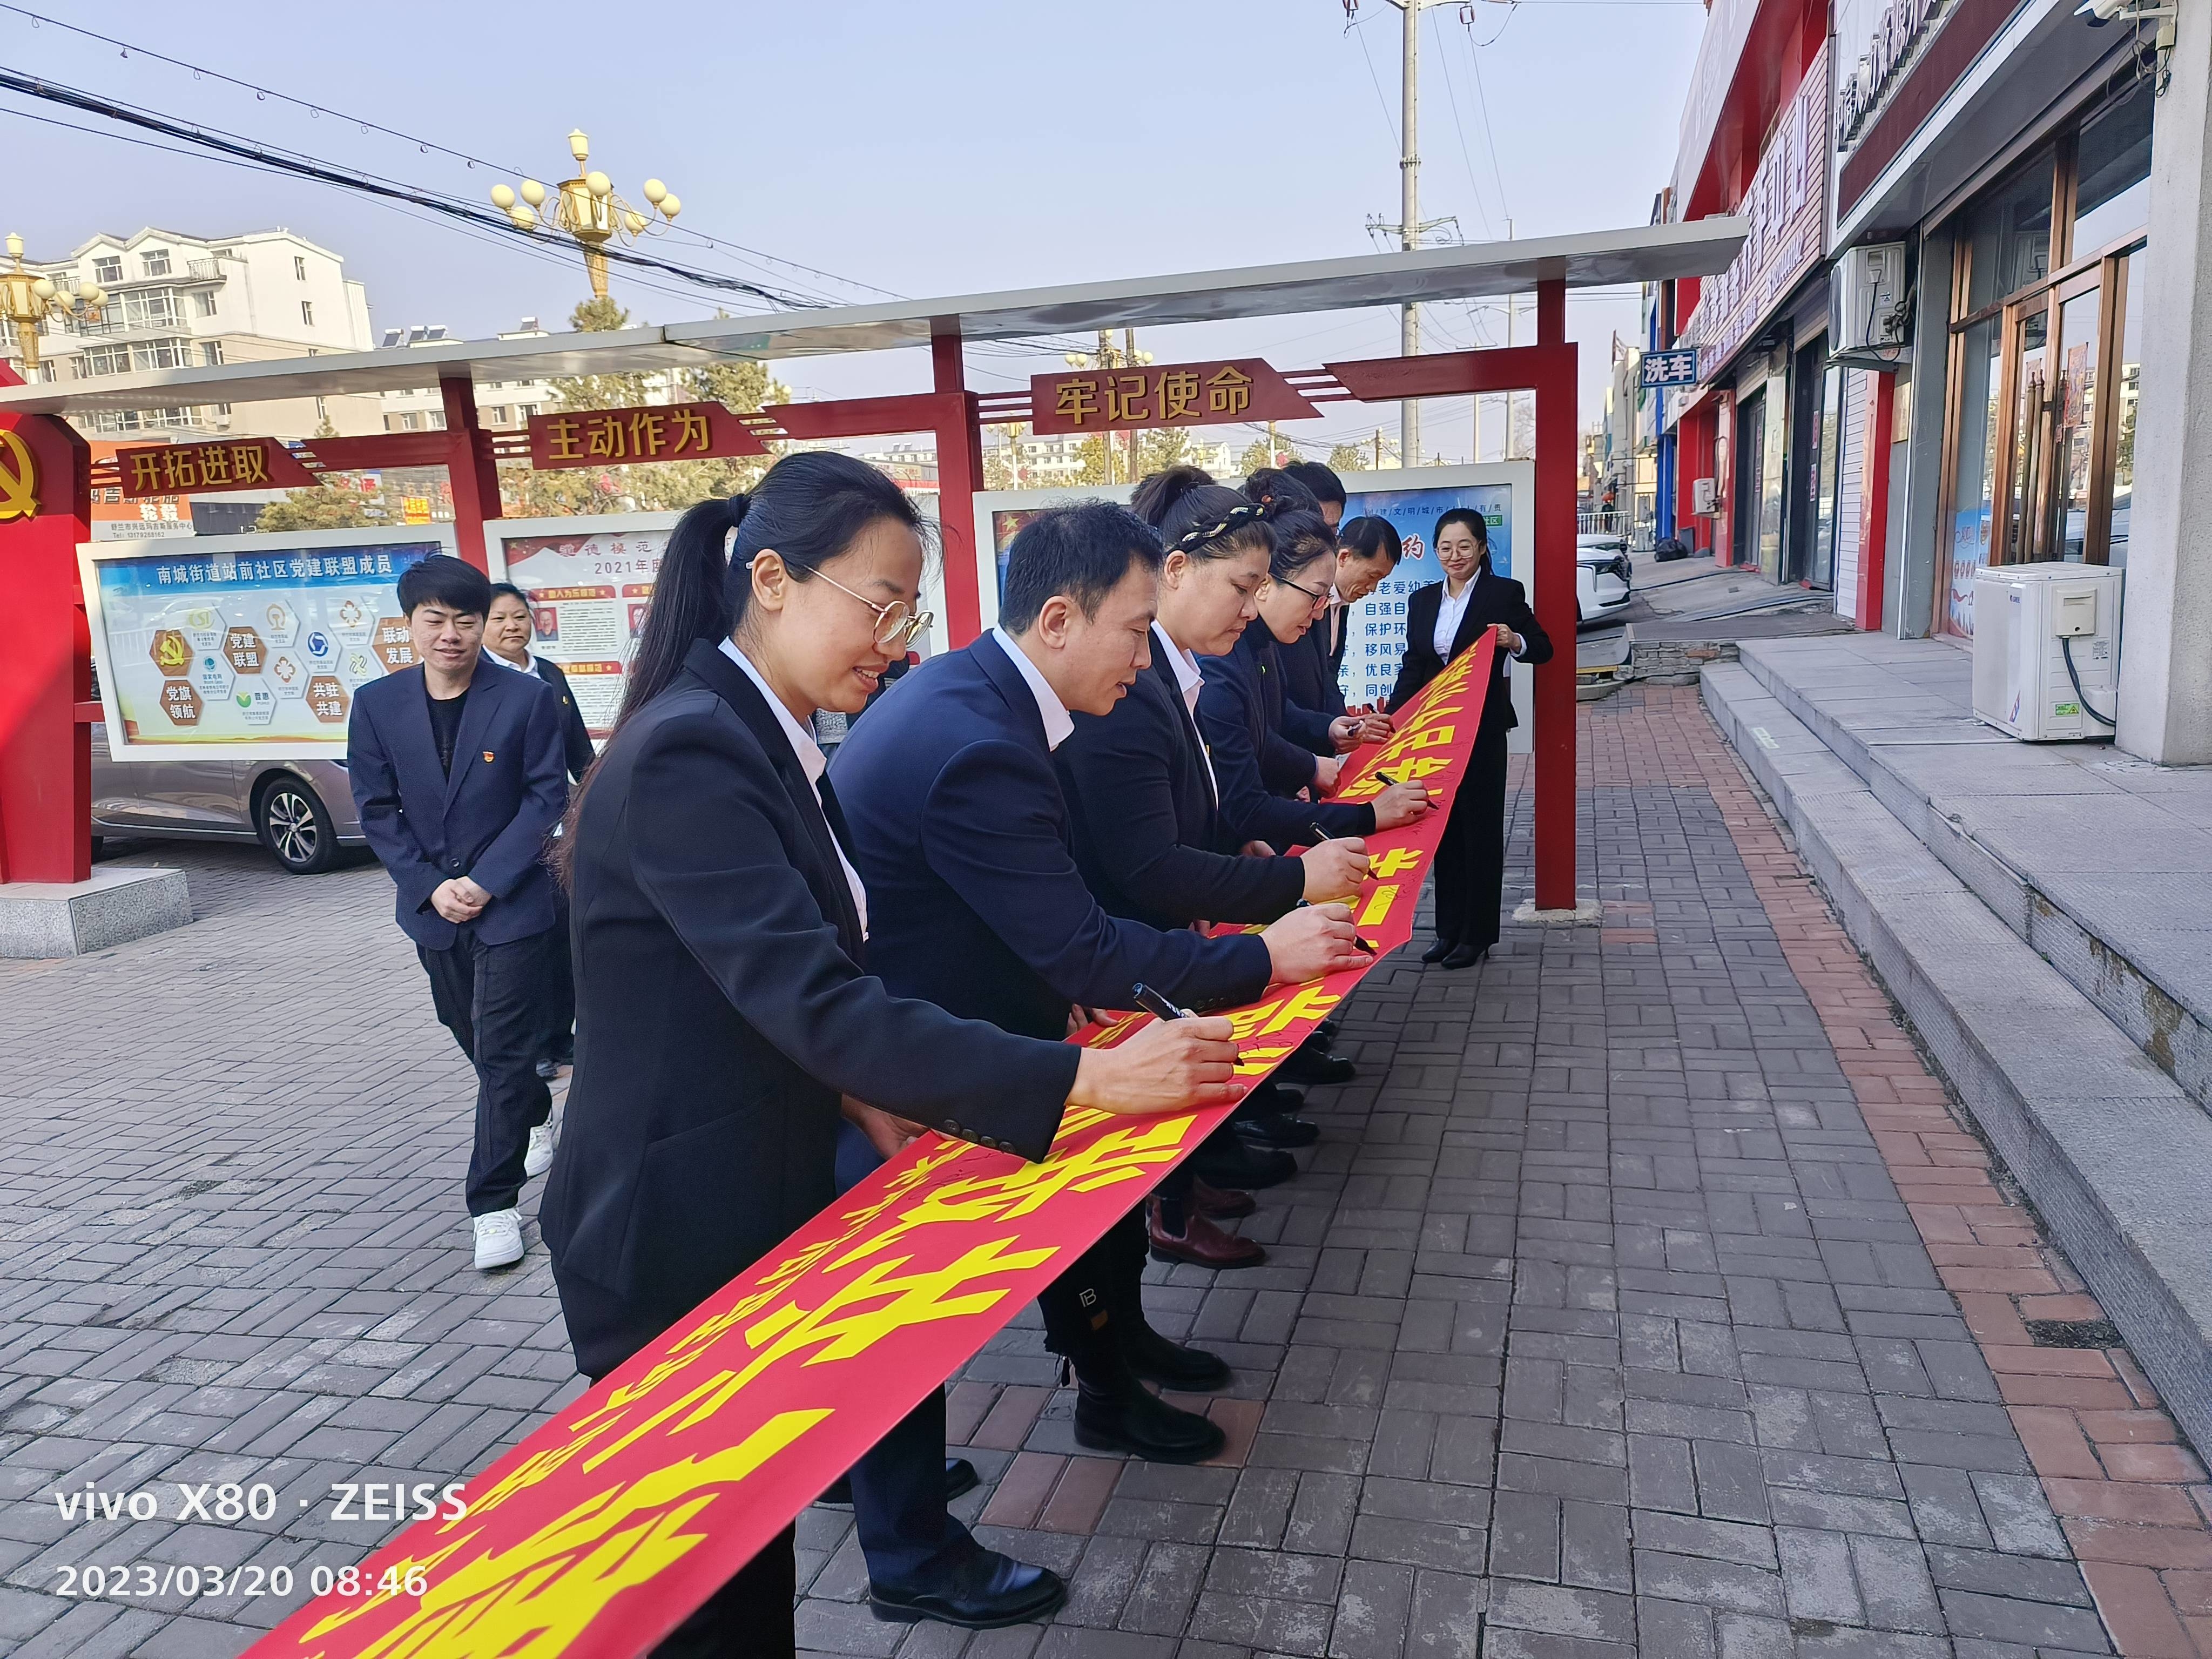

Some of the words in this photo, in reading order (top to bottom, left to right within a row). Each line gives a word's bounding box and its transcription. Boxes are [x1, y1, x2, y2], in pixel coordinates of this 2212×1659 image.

[1644, 355, 1692, 383] 洗车
[1055, 366, 1253, 425] 牢记使命
[547, 409, 710, 460] 主动作为
[130, 446, 268, 491] 开拓进取
[559, 541, 670, 557] 道德模范
[1403, 534, 1424, 559] 约
[156, 555, 393, 584] 南城街道站前社区党建联盟成员
[230, 632, 257, 648] 党建
[382, 626, 410, 644] 联动
[233, 652, 259, 667] 联盟
[386, 647, 414, 664] 发展
[166, 685, 192, 701] 党旗
[313, 682, 340, 698] 共驻
[170, 704, 195, 719] 领航
[316, 701, 342, 717] 共建
